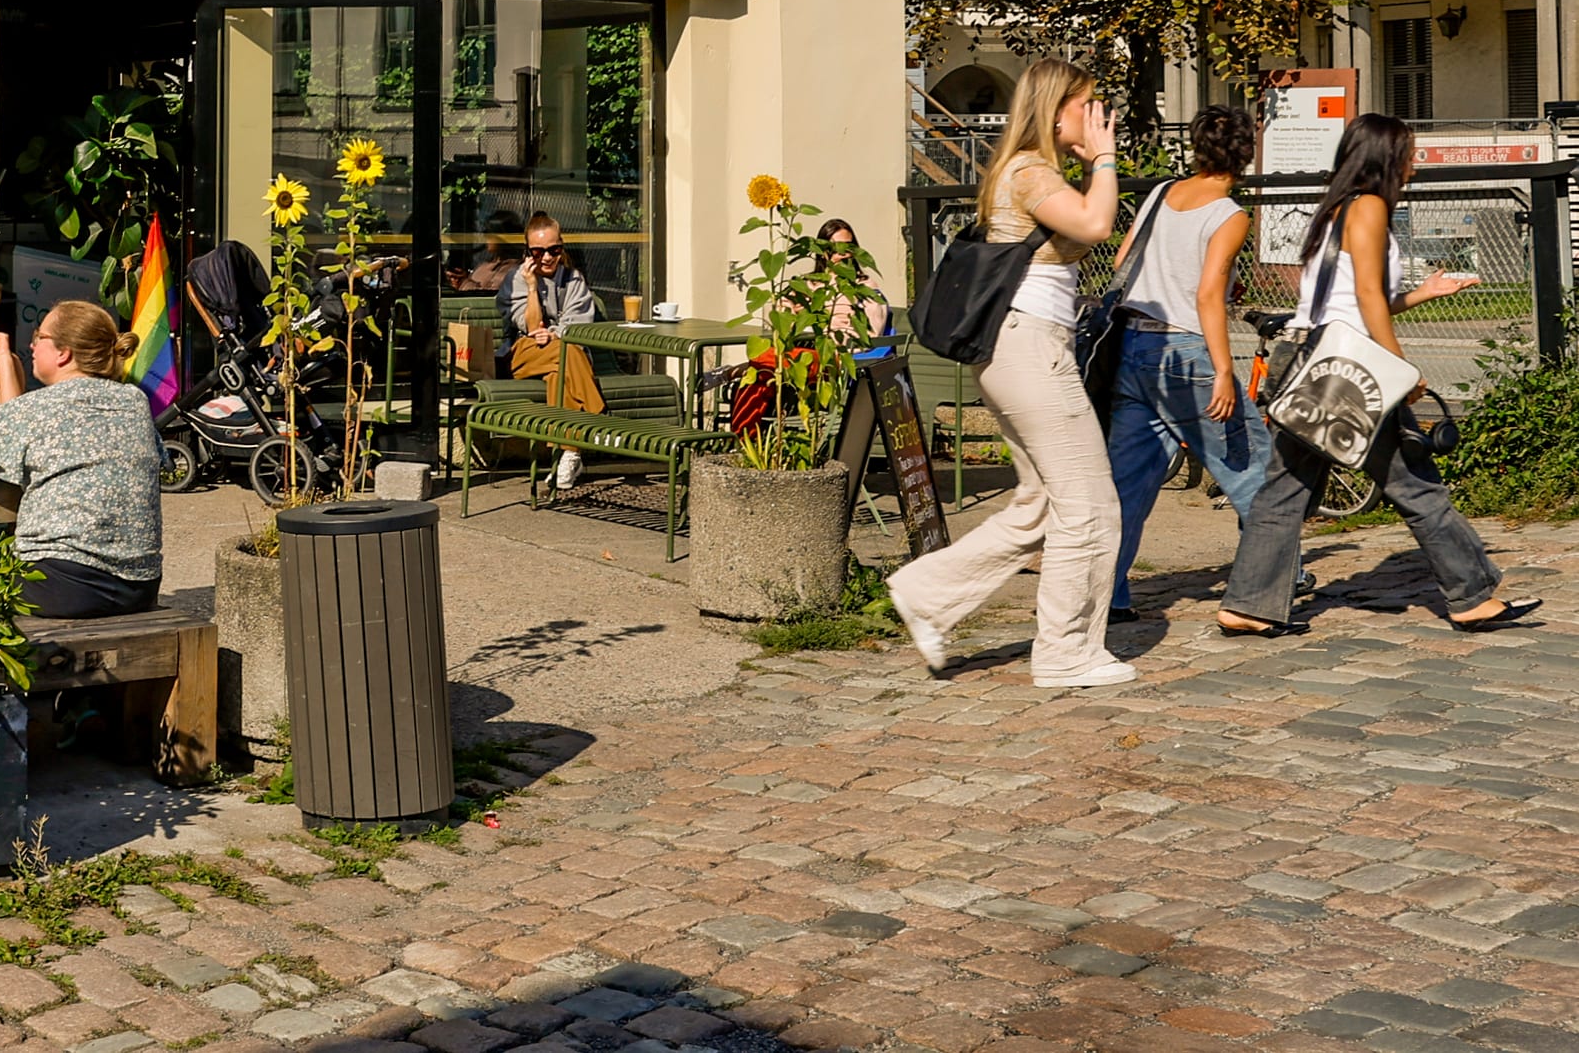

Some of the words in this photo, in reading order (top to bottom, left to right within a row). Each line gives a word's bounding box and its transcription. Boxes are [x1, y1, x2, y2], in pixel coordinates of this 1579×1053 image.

[1443, 154, 1469, 163] READ
[1471, 153, 1507, 162] BELOW
[1310, 360, 1382, 412] BROOKLYN
